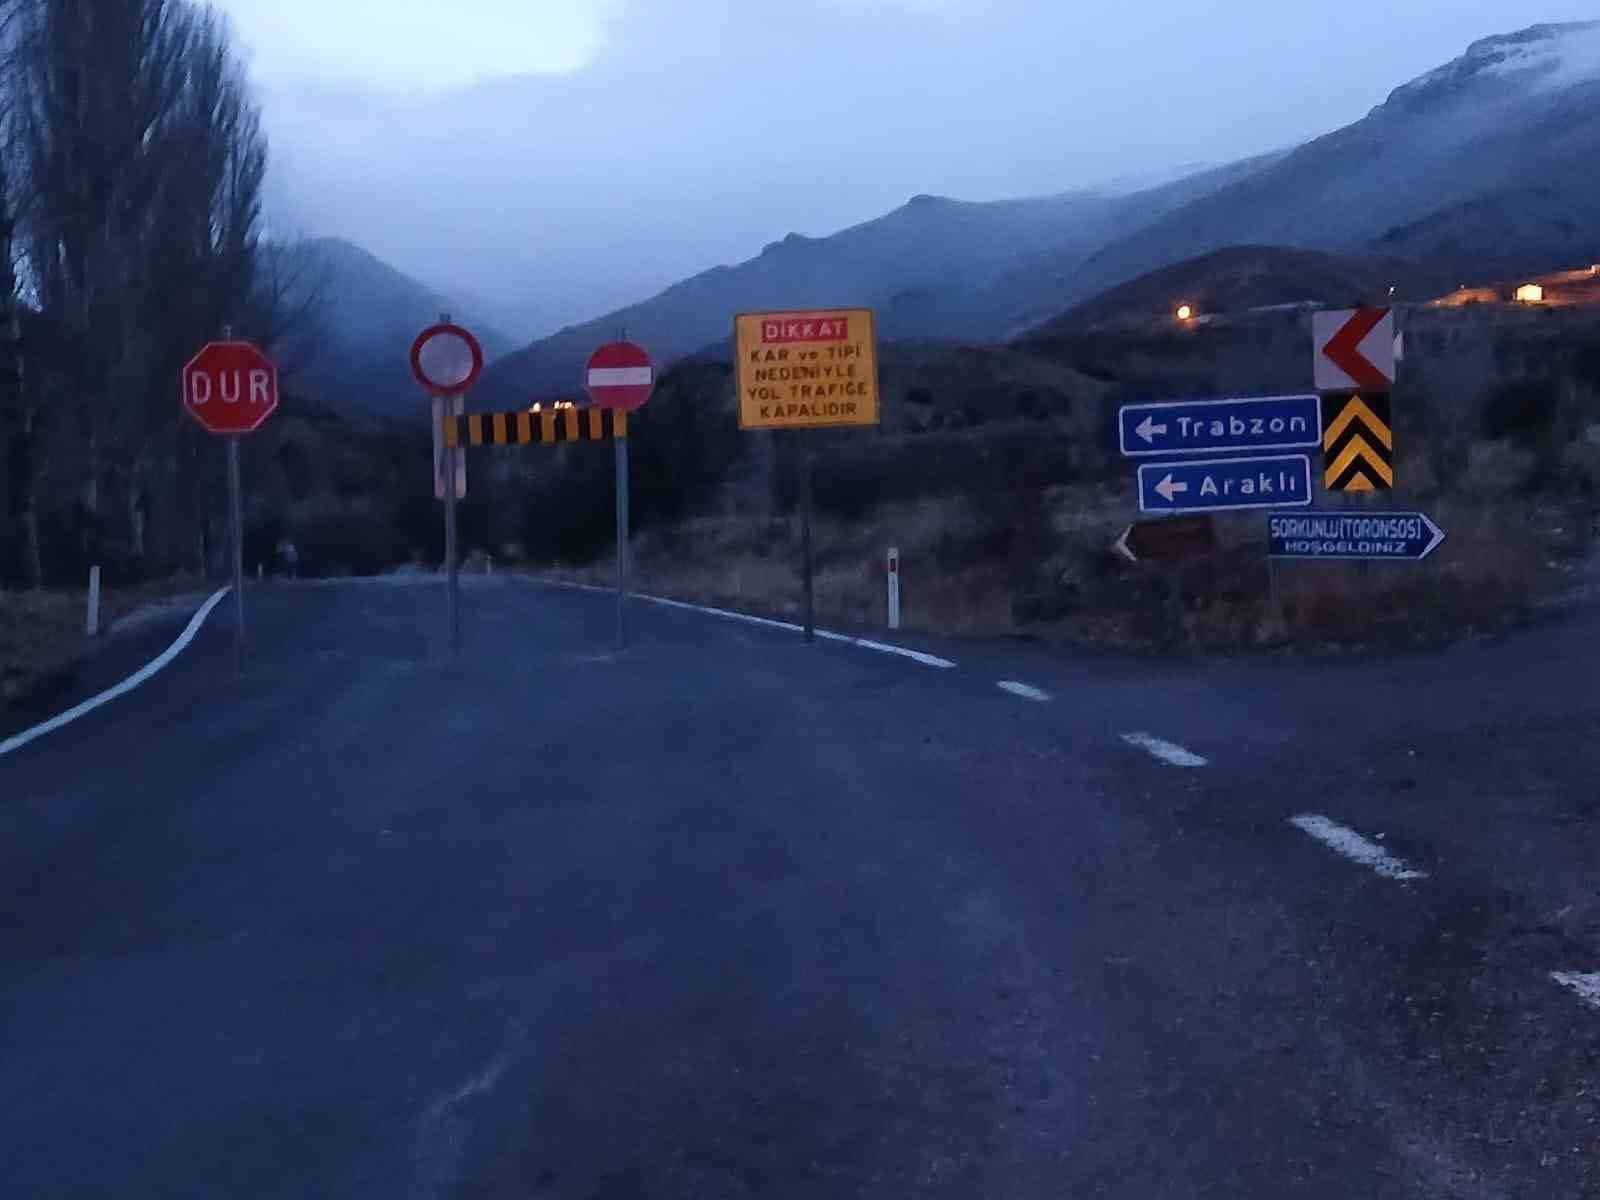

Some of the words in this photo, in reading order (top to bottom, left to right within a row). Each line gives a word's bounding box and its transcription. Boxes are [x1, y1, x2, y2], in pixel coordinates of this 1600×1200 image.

[750, 349, 789, 361] KAR
[799, 351, 818, 360] ve
[192, 368, 269, 404] DUR
[748, 387, 780, 400] YOL
[760, 402, 857, 418] KAPALIDIR
[1177, 416, 1306, 437] Trabzon
